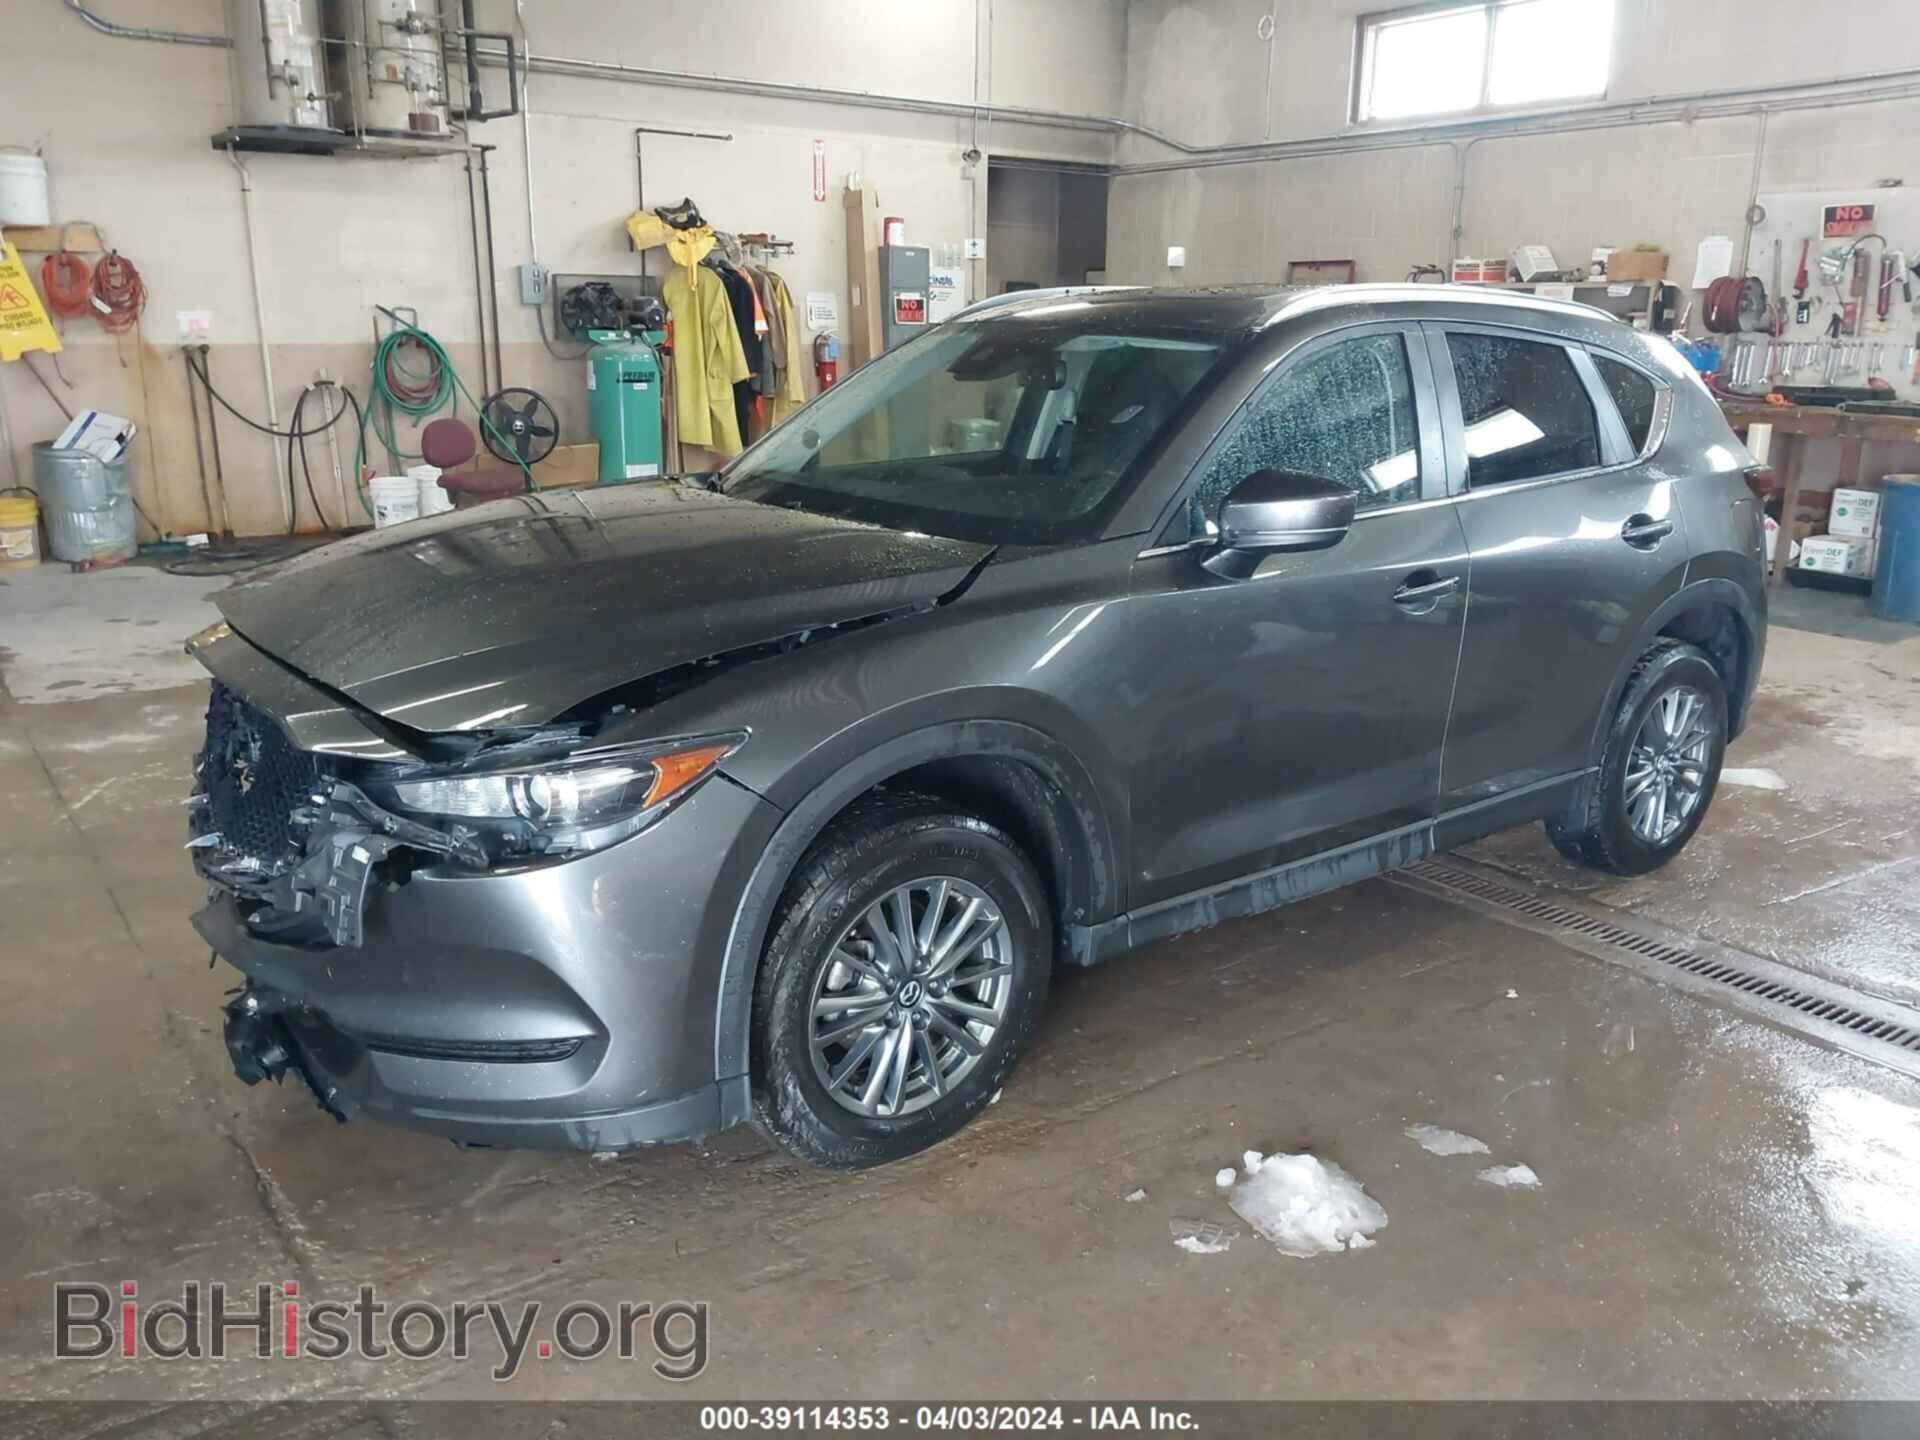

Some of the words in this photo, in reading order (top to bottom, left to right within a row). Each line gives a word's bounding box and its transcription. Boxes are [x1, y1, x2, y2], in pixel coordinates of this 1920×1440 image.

[1836, 207, 1863, 219] NO
[901, 300, 917, 310] NO
[1825, 547, 1842, 557] DEF
